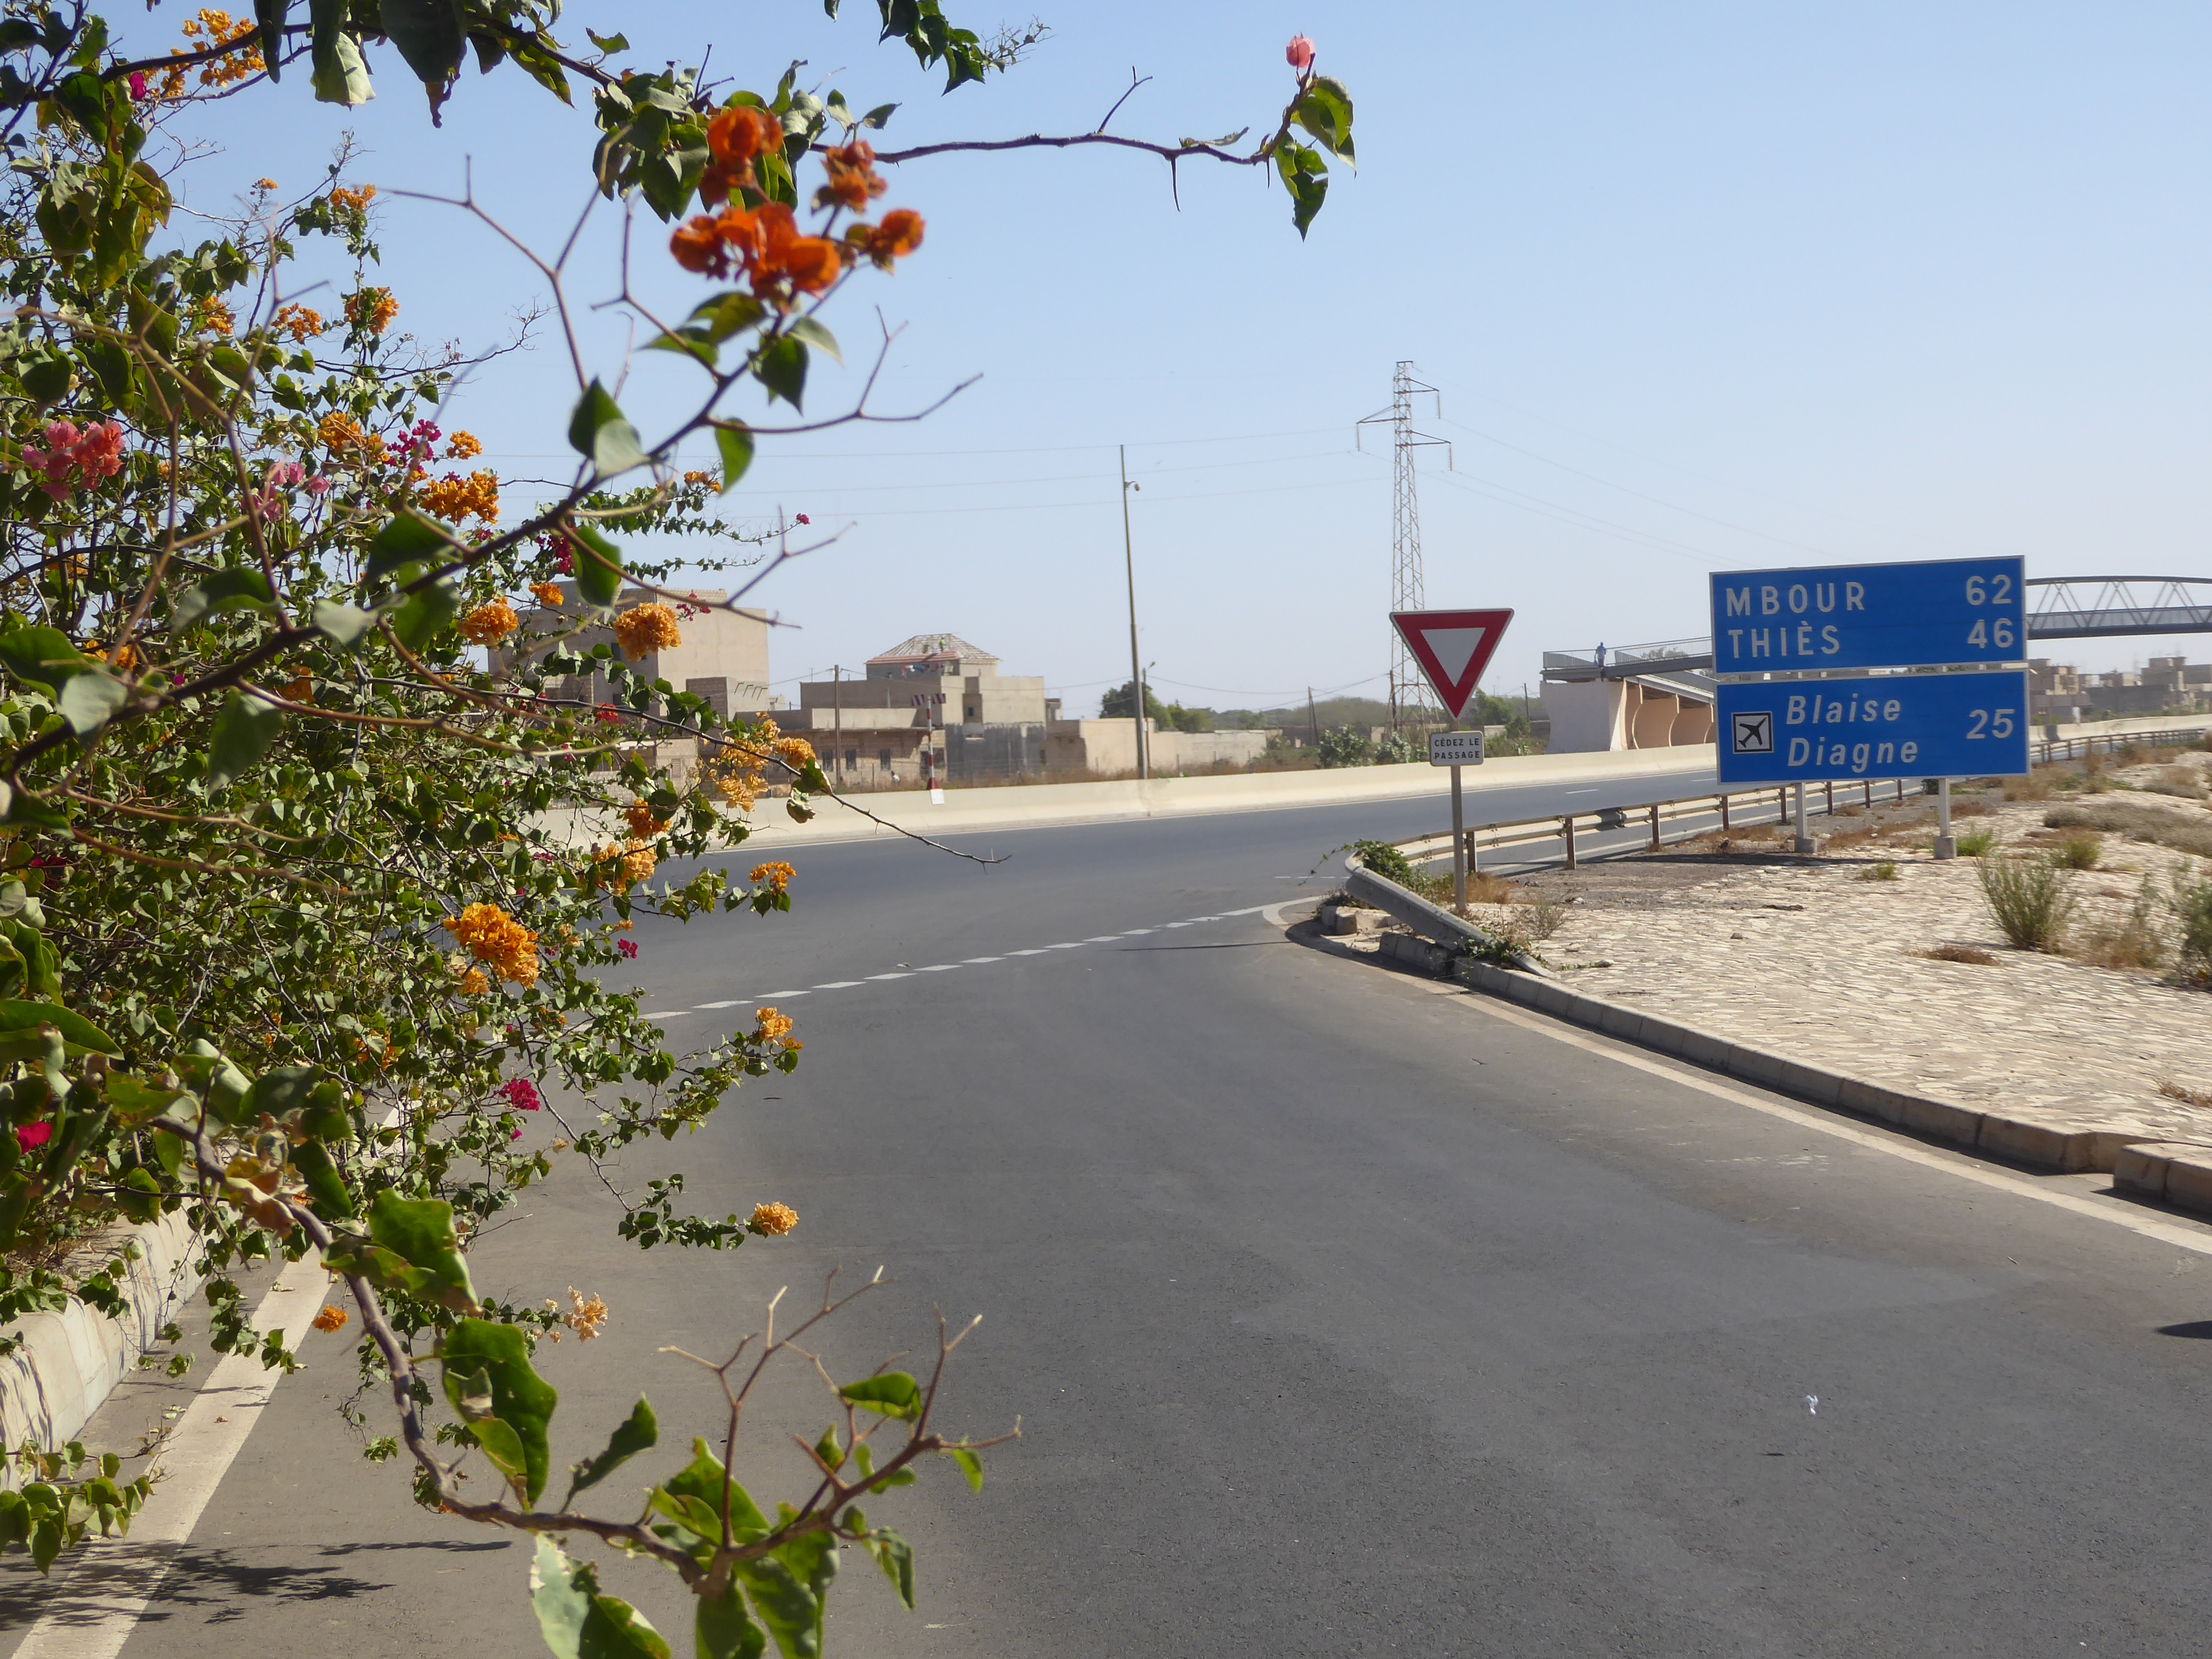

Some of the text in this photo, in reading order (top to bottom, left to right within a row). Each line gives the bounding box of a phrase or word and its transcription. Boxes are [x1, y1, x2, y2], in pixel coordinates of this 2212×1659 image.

[1726, 574, 2012, 617] MBOUR 62
[1728, 618, 2014, 659] THIÈS 46
[1786, 693, 1901, 725] Blaise
[1966, 709, 2015, 739] 25
[1434, 751, 1479, 759] PASSAGE
[1787, 737, 1918, 773] Diagne
